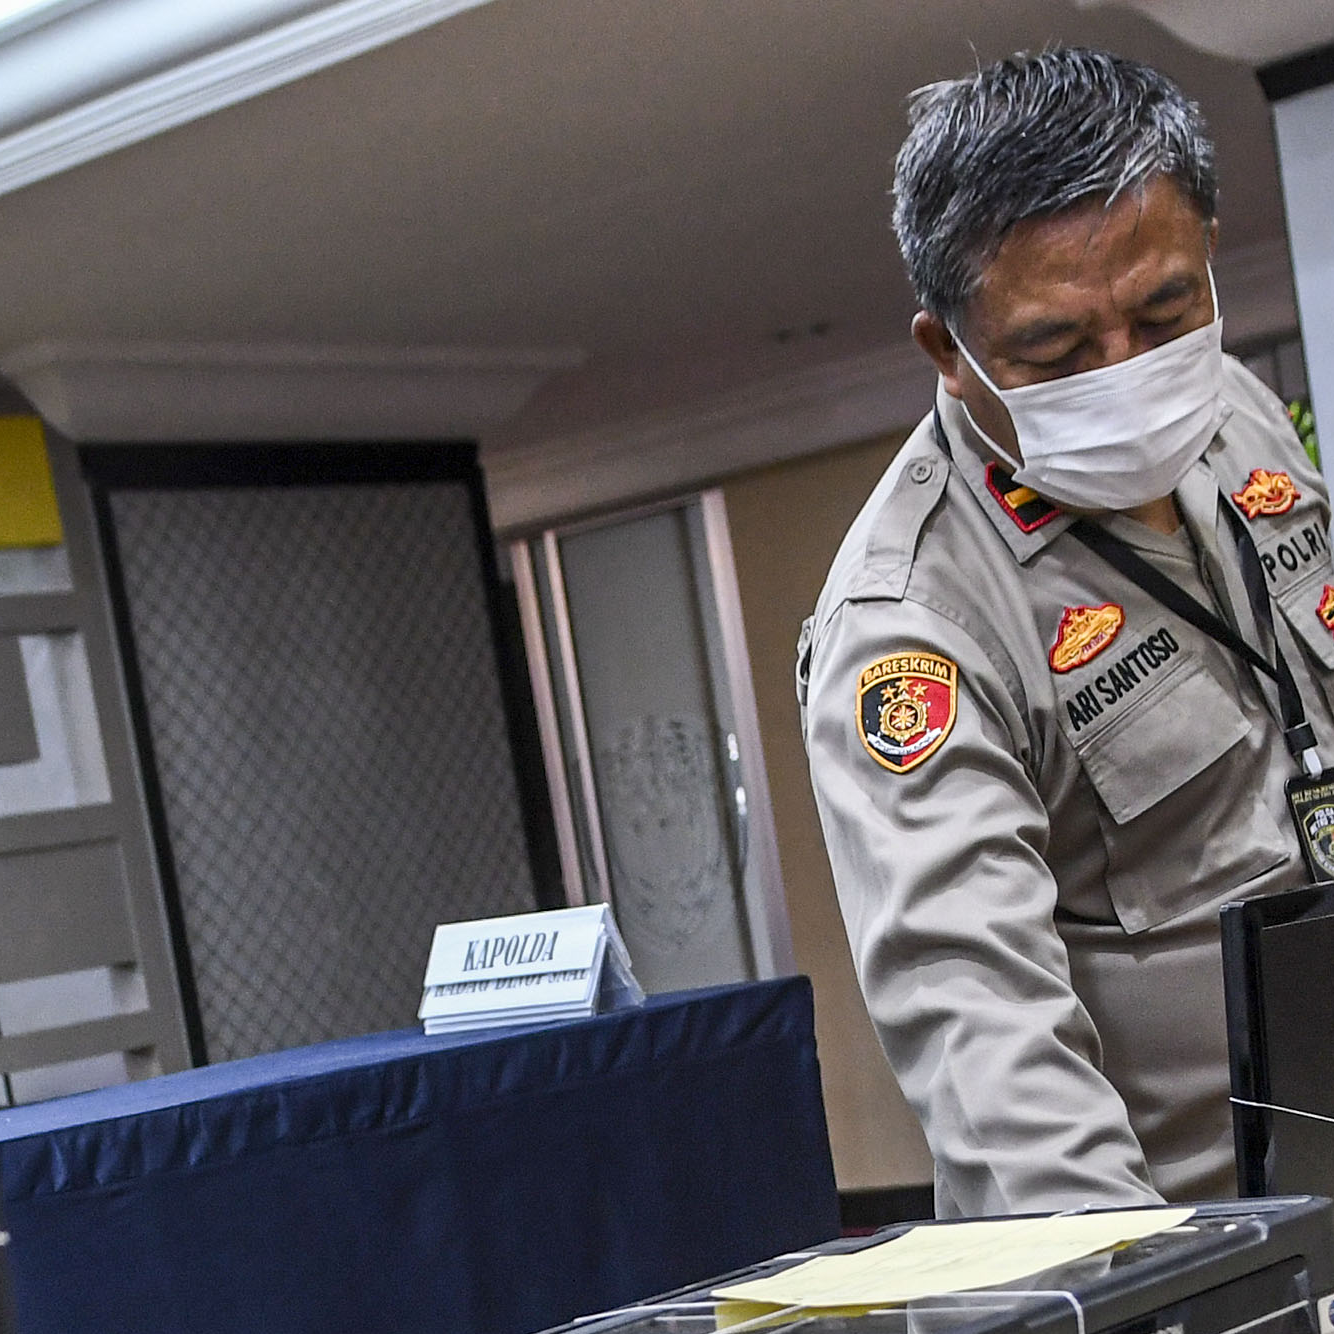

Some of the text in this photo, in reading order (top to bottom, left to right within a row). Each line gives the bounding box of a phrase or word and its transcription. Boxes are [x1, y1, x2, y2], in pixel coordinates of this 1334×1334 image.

[1260, 522, 1328, 582] POLRI
[864, 656, 948, 684] BARESKRIM
[1066, 627, 1180, 732] ARI SANTOSO
[462, 931, 560, 972] KAPOLDA
